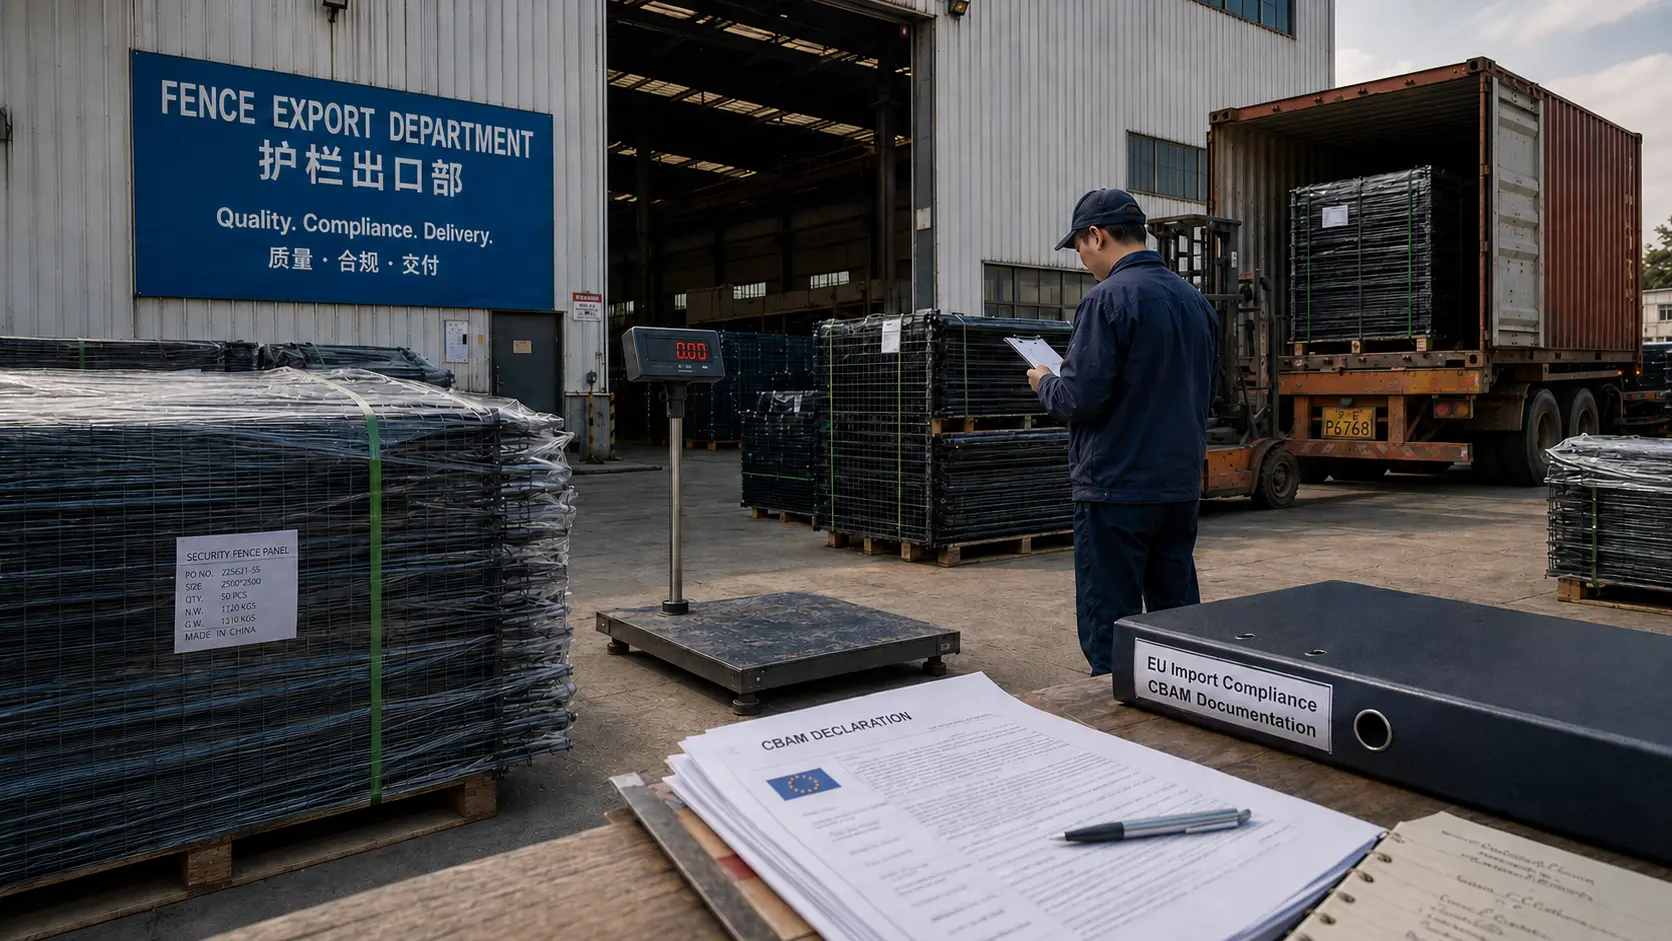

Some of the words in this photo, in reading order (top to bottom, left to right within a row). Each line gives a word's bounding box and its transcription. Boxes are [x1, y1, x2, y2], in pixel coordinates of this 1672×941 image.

[161, 79, 256, 124] FENCE
[273, 95, 376, 138] EXPORT
[389, 111, 534, 159] DEPARTMENT
[258, 140, 463, 198] 护栏出口部
[216, 207, 296, 235] Quality.
[303, 213, 418, 240] Compliance.
[424, 222, 493, 247] Delivery.
[268, 247, 313, 271] 质量
[337, 250, 379, 274] 合规
[402, 254, 440, 277] 交付
[676, 341, 707, 360] 0.00
[1325, 420, 1369, 435] P6768
[187, 551, 230, 561] SECURITY
[232, 548, 260, 558] FENCE
[263, 546, 289, 555] PANEL
[185, 571, 197, 579] PO
[198, 569, 214, 578] NO.
[185, 582, 202, 591] SIZE
[185, 595, 204, 604] QTY.
[221, 592, 231, 601] 50
[233, 591, 248, 600] PCS
[241, 602, 257, 611] KGS
[240, 614, 256, 623] KGS
[185, 630, 211, 641] MADE
[216, 629, 226, 637] IN
[229, 627, 256, 636] CHINA
[1147, 655, 1167, 673] EU
[1171, 662, 1219, 687] Import
[1222, 675, 1318, 712] Compliance
[1148, 679, 1192, 703] CBAM
[1196, 692, 1317, 738] Documentation
[761, 732, 810, 752] CBAM
[810, 711, 914, 741] DECLARATION
